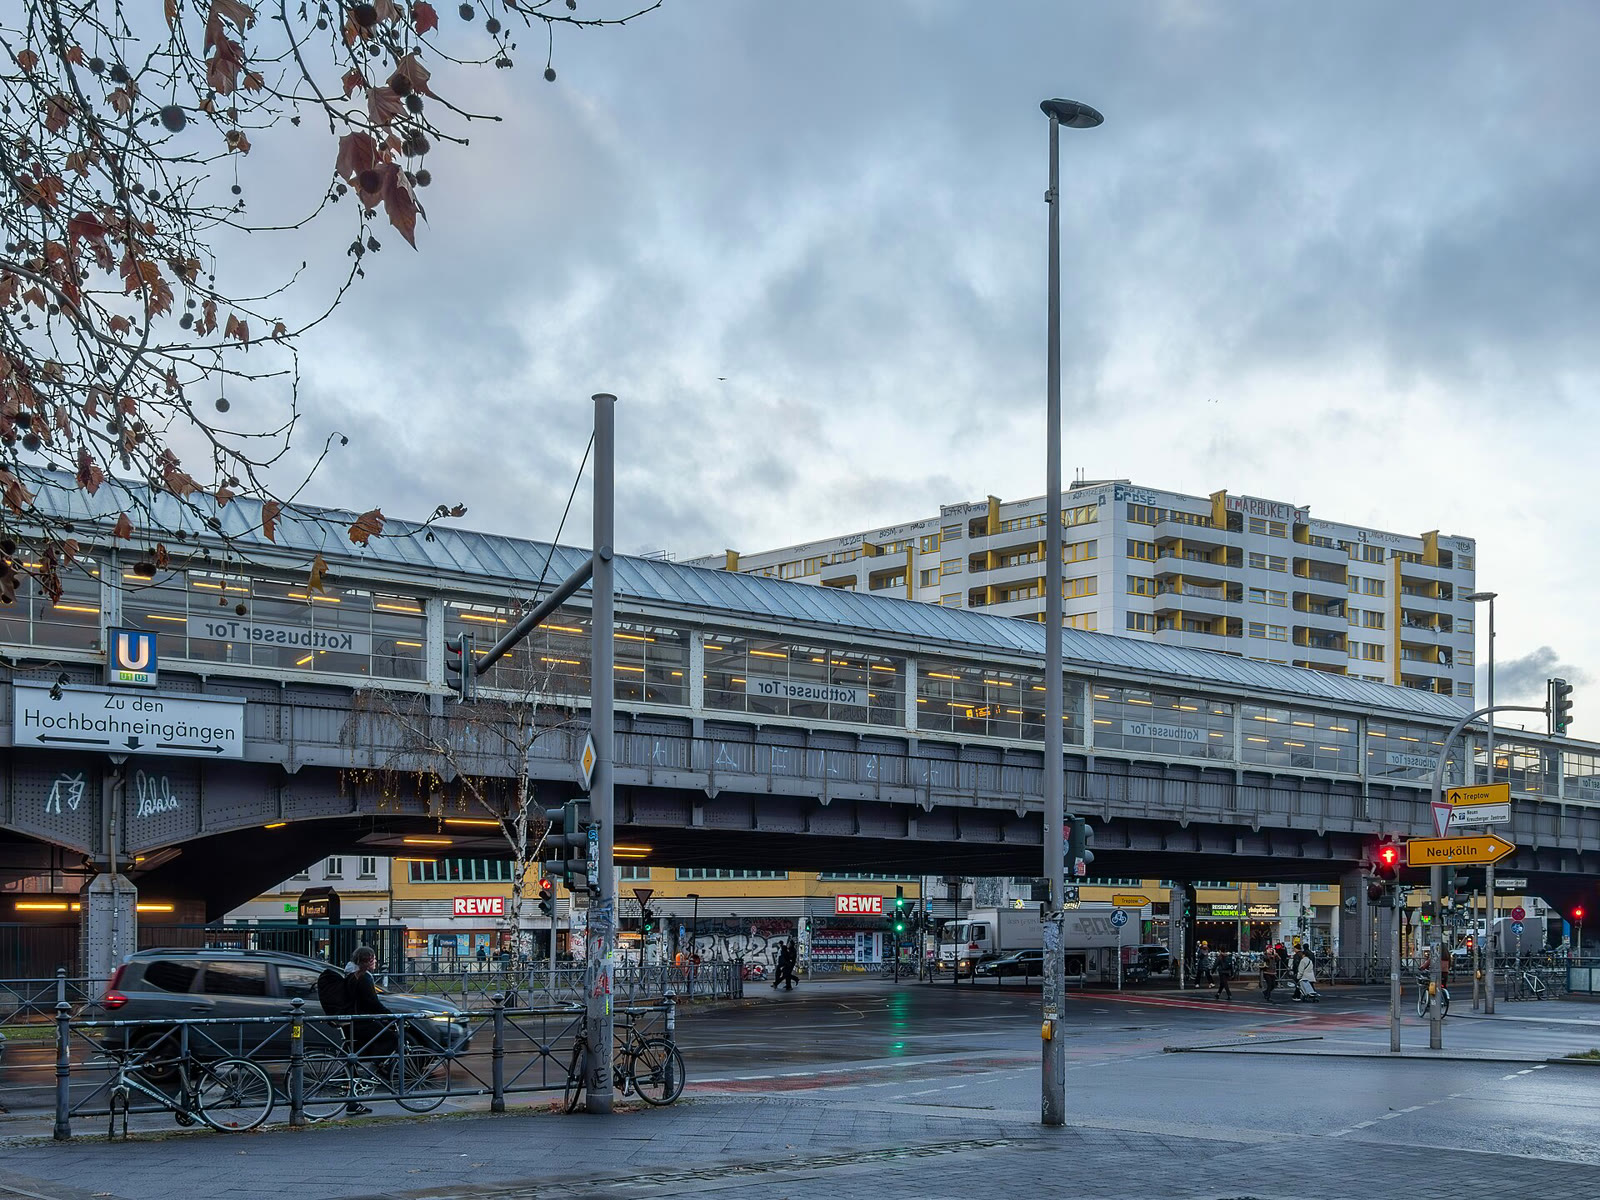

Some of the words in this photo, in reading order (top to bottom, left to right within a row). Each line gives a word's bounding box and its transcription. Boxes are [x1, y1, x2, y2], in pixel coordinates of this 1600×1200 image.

[118, 633, 149, 670] U
[120, 673, 133, 681] U1
[136, 674, 147, 682] U3
[104, 694, 125, 710] Zu
[132, 697, 164, 712] den
[25, 709, 235, 743] Hochbahneingängen
[1464, 793, 1490, 801] Treptow
[1426, 845, 1477, 857] Neukölln
[455, 898, 503, 914] REWE
[837, 896, 881, 912] REWE
